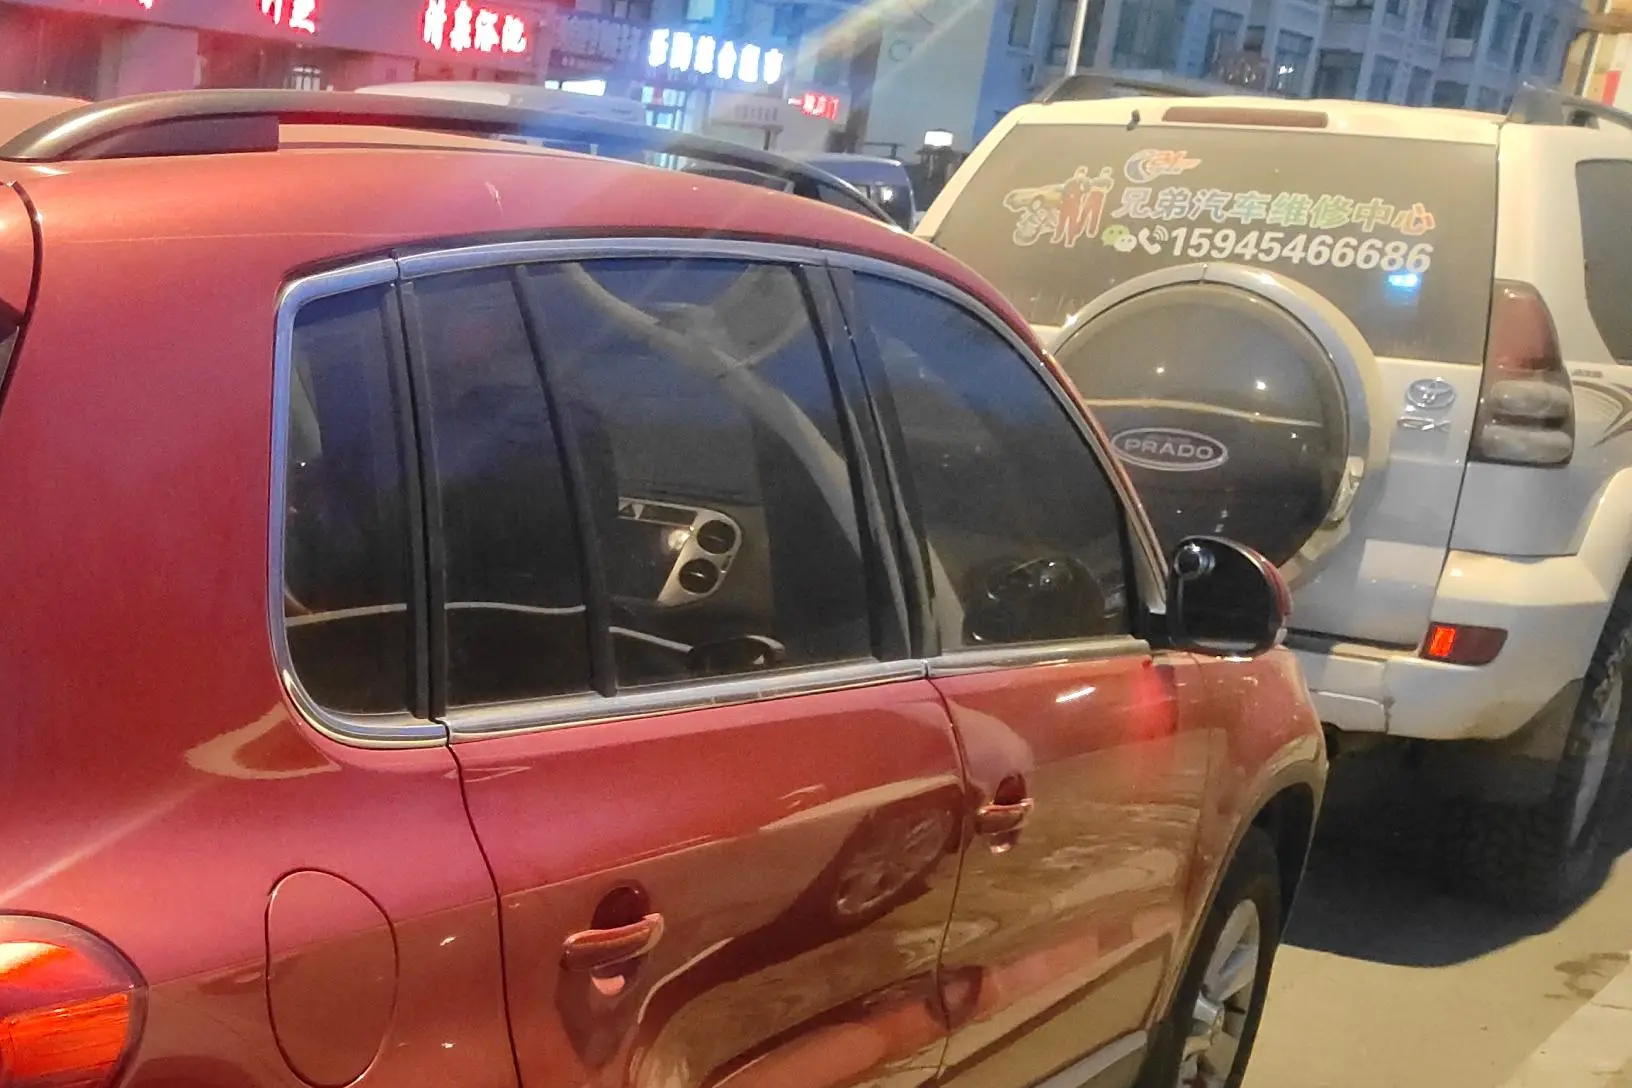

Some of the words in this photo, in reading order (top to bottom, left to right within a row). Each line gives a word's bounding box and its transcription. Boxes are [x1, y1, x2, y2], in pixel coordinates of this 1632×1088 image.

[1111, 186, 1435, 236] 兄弟汽车维修中心
[1170, 227, 1434, 273] 15945466686
[1124, 439, 1214, 460] PRADO
